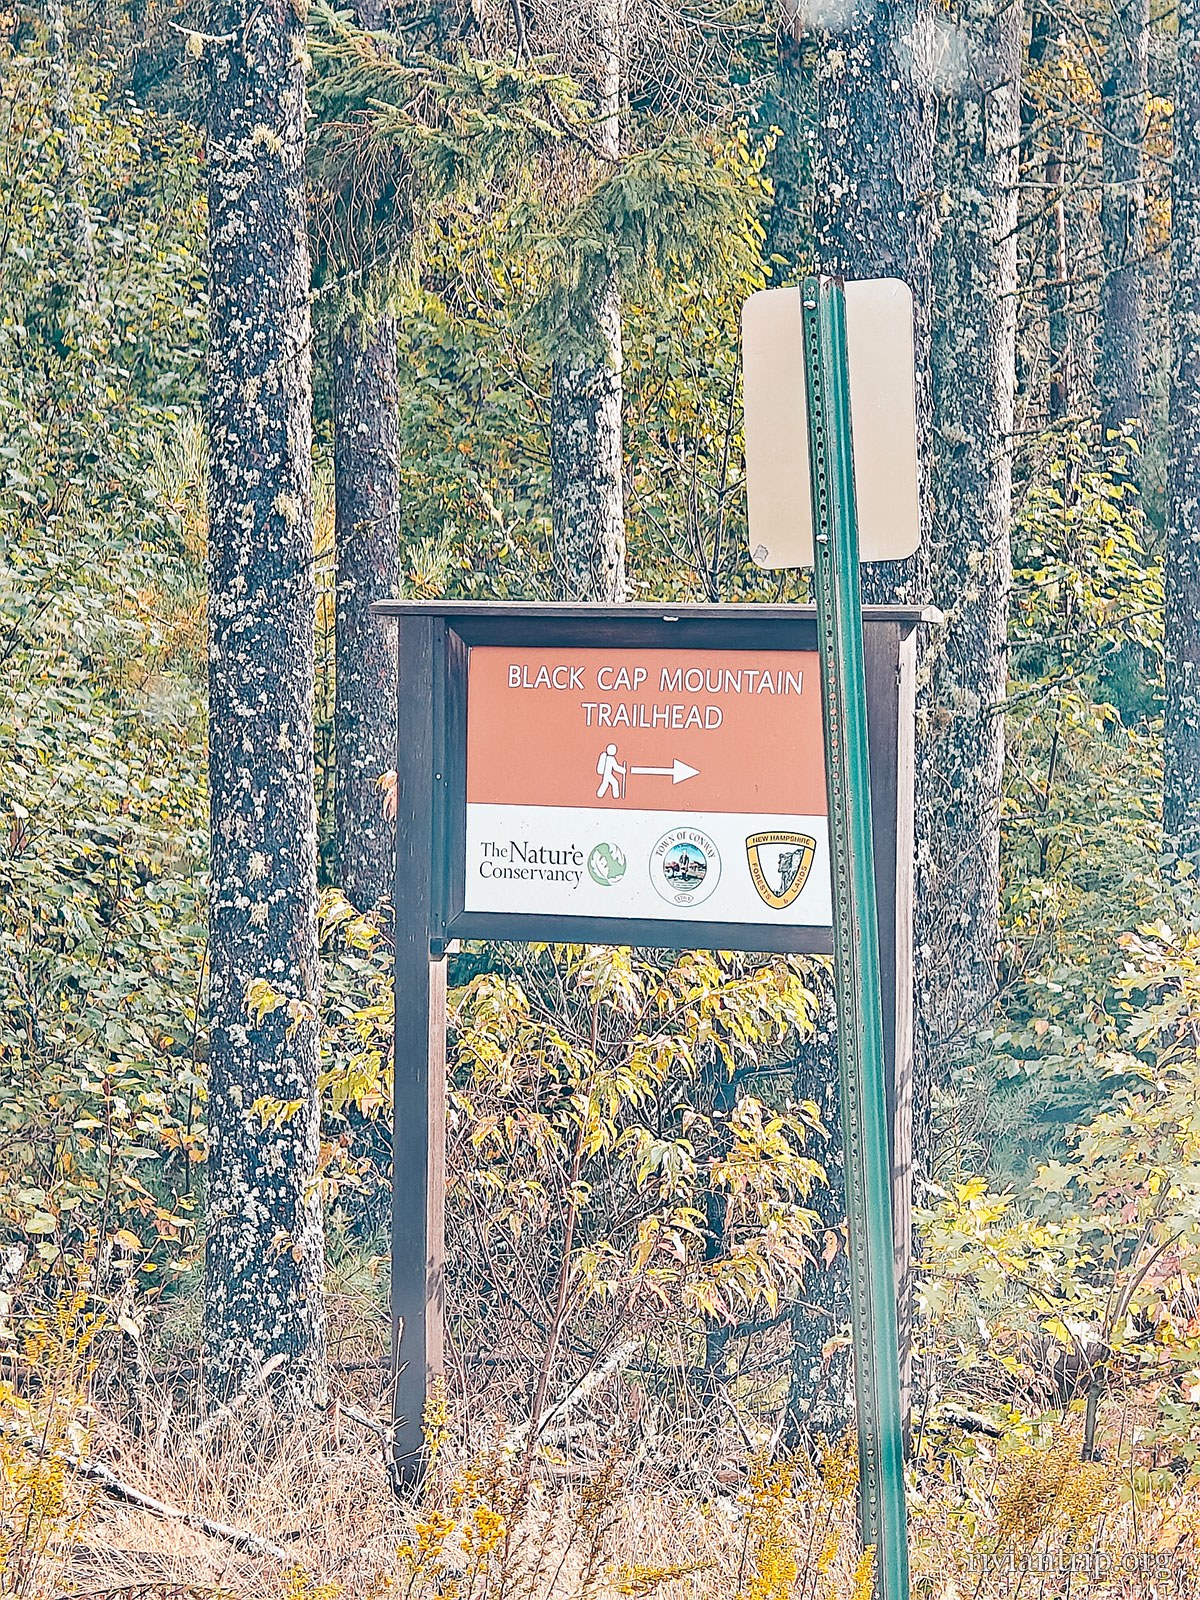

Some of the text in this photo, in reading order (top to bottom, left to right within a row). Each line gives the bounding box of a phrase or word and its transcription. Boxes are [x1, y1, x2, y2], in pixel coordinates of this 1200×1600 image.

[508, 665, 804, 695] BLACK CAP MOUNTAIN
[581, 702, 724, 730] TRAILHEAD
[480, 840, 584, 866] The Nature
[655, 831, 716, 859] TOWN OF CONWAY
[752, 835, 811, 846] NEW HAMPSHIRE
[479, 860, 583, 890] Conservancy
[751, 862, 772, 900] FORESTS
[791, 865, 808, 893] LANDS
